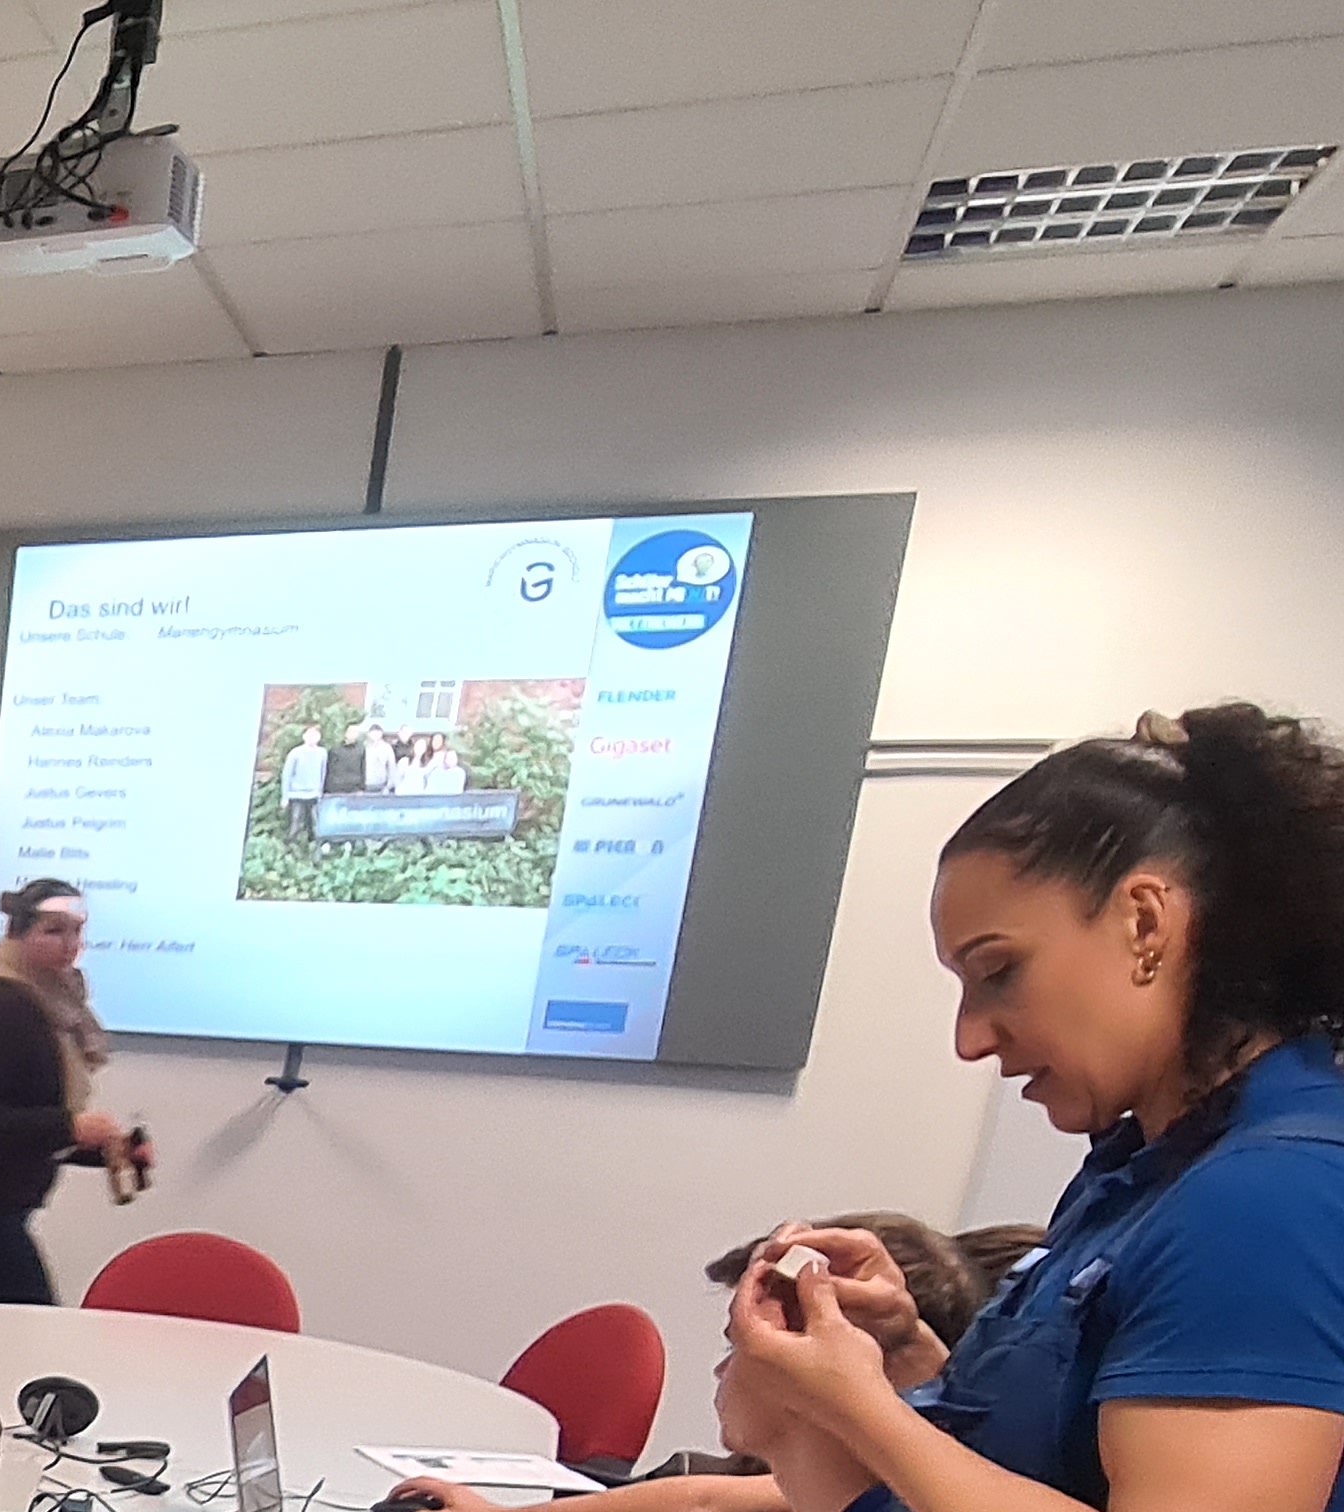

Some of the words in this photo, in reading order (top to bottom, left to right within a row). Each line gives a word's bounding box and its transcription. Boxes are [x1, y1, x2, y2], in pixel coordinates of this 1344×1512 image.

[49, 599, 91, 620] Das
[99, 597, 144, 617] sind
[151, 595, 190, 615] wir!
[598, 690, 676, 703] FLENDER
[590, 736, 671, 759] Gigaset
[594, 839, 665, 855] PIERN
